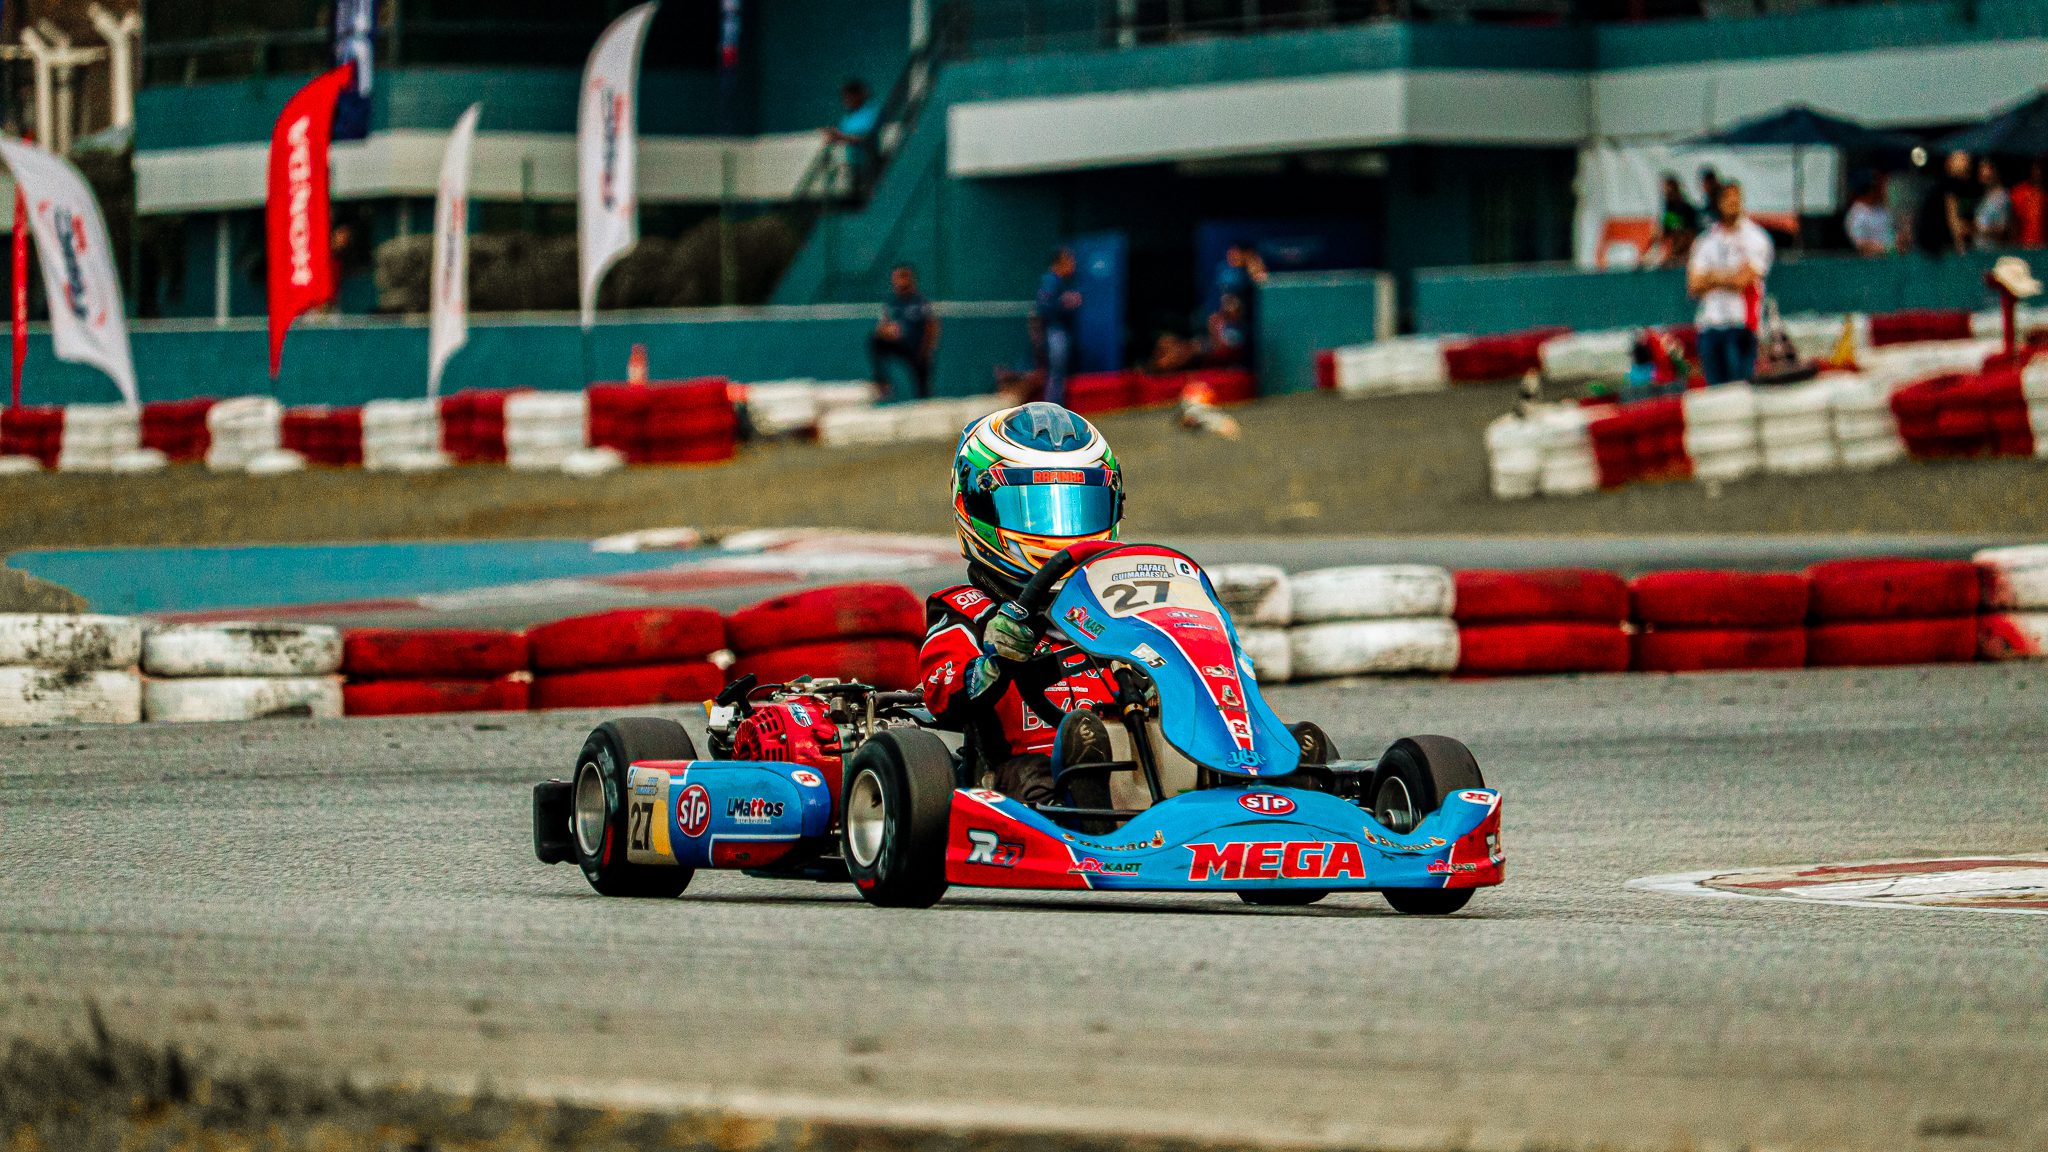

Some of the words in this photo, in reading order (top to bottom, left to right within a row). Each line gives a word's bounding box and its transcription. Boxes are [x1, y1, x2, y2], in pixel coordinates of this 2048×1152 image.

[287, 115, 311, 286] HONDA
[1033, 470, 1085, 484] RAFINHA
[1137, 563, 1166, 572] RAFAEL
[1102, 581, 1171, 614] 27
[679, 791, 707, 830] STP
[1246, 794, 1289, 811] STP
[630, 803, 654, 850] 27
[1183, 841, 1366, 881] MEGA
